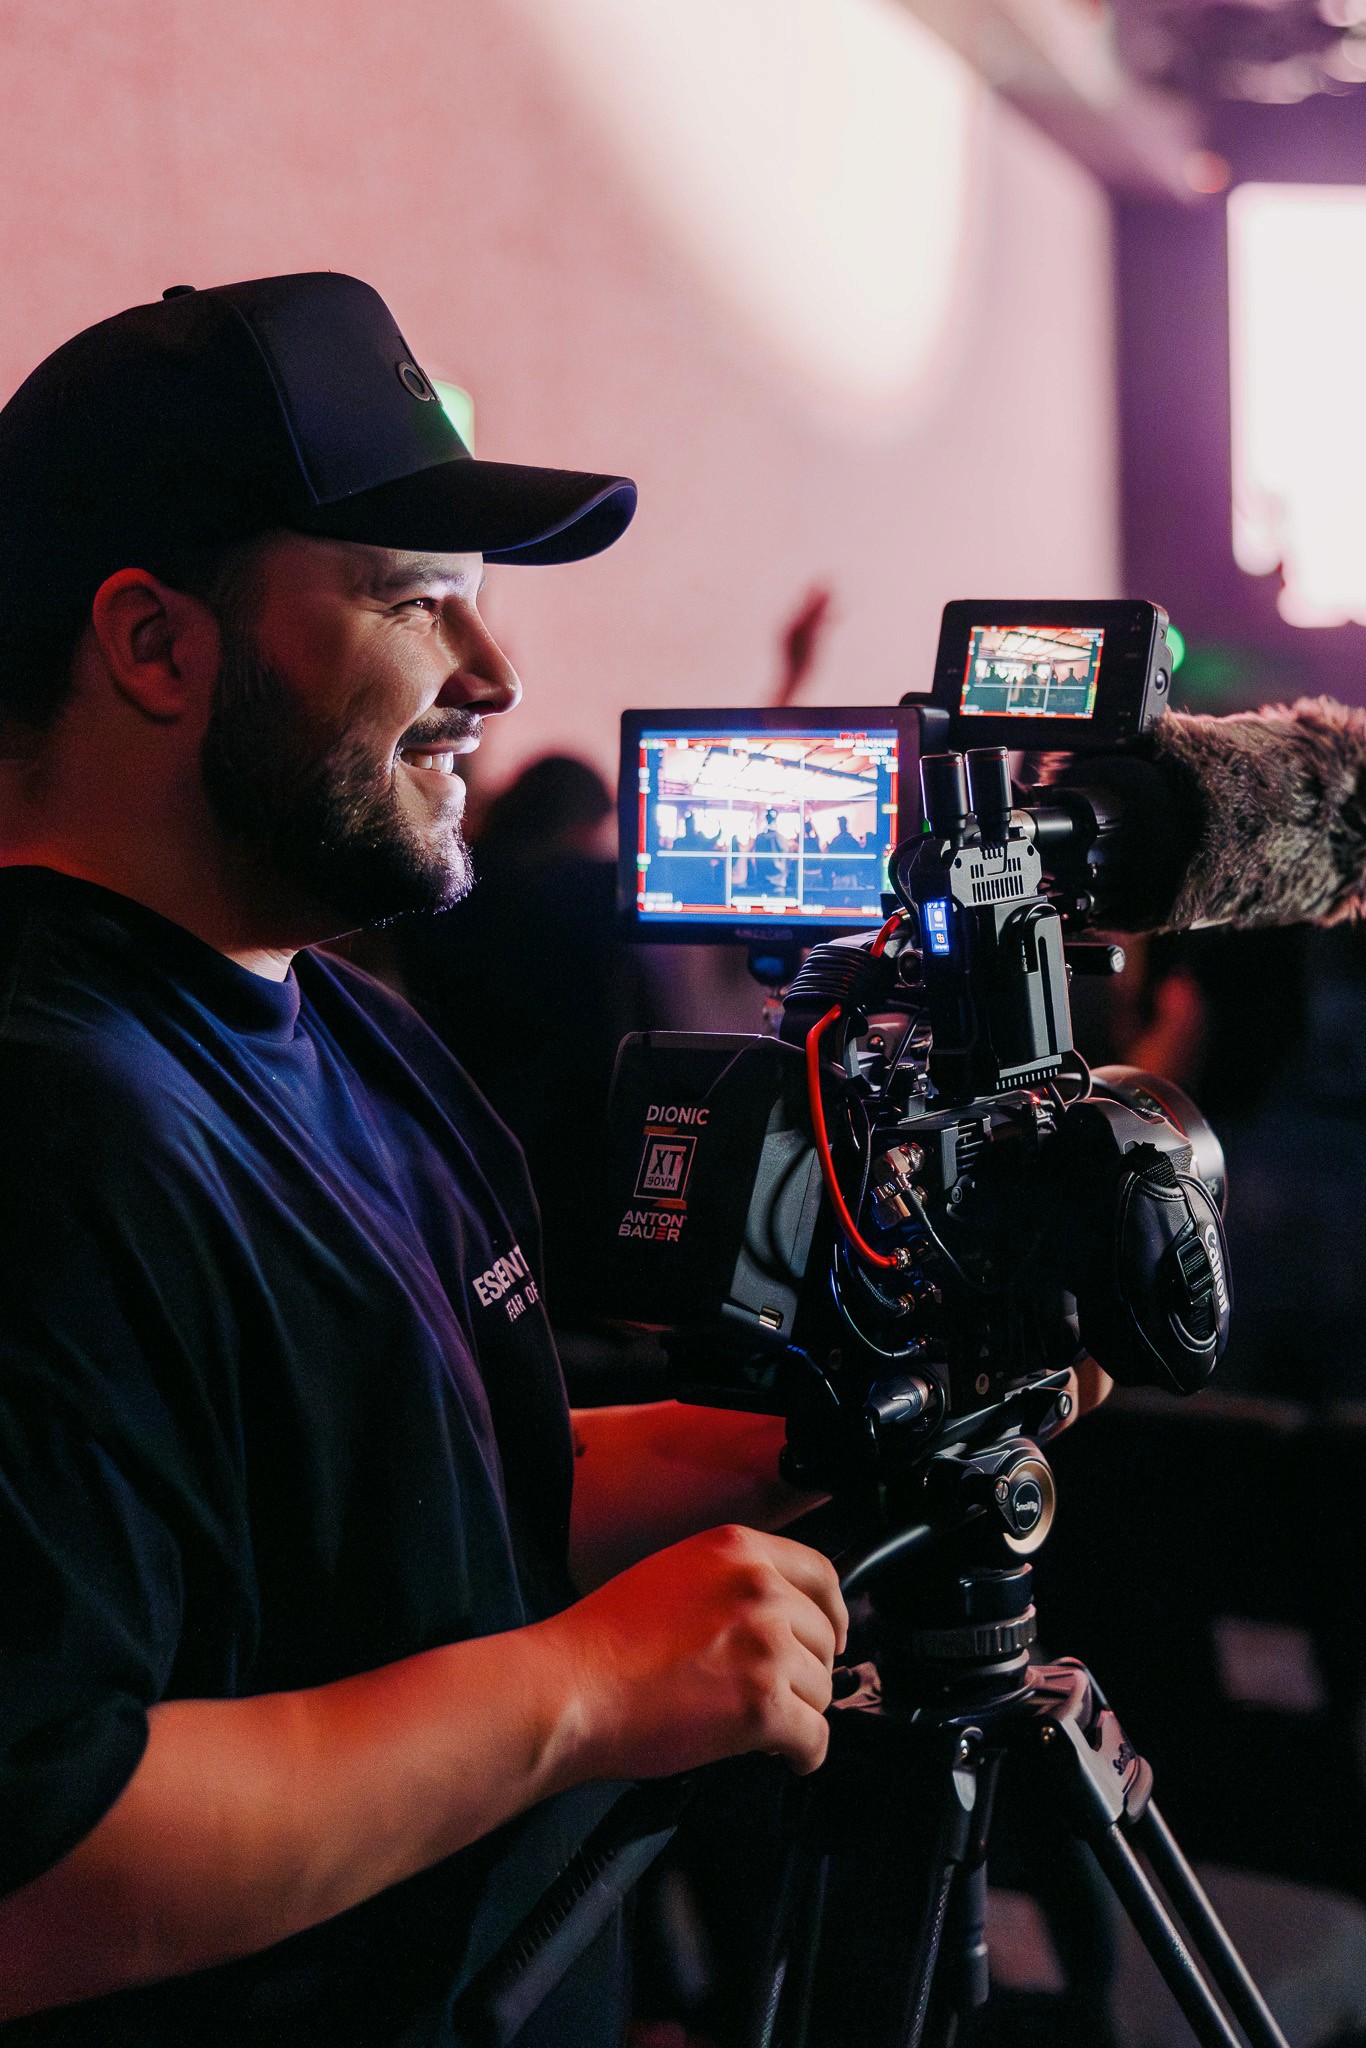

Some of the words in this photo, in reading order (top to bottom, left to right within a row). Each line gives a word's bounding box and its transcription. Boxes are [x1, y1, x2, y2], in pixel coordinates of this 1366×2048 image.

[646, 1104, 710, 1125] DIONIC
[650, 1149, 685, 1176] XT
[646, 1176, 676, 1188] 90VM
[621, 1210, 685, 1229] ANTON
[618, 1223, 681, 1242] BAUER
[1205, 1224, 1228, 1314] Canon
